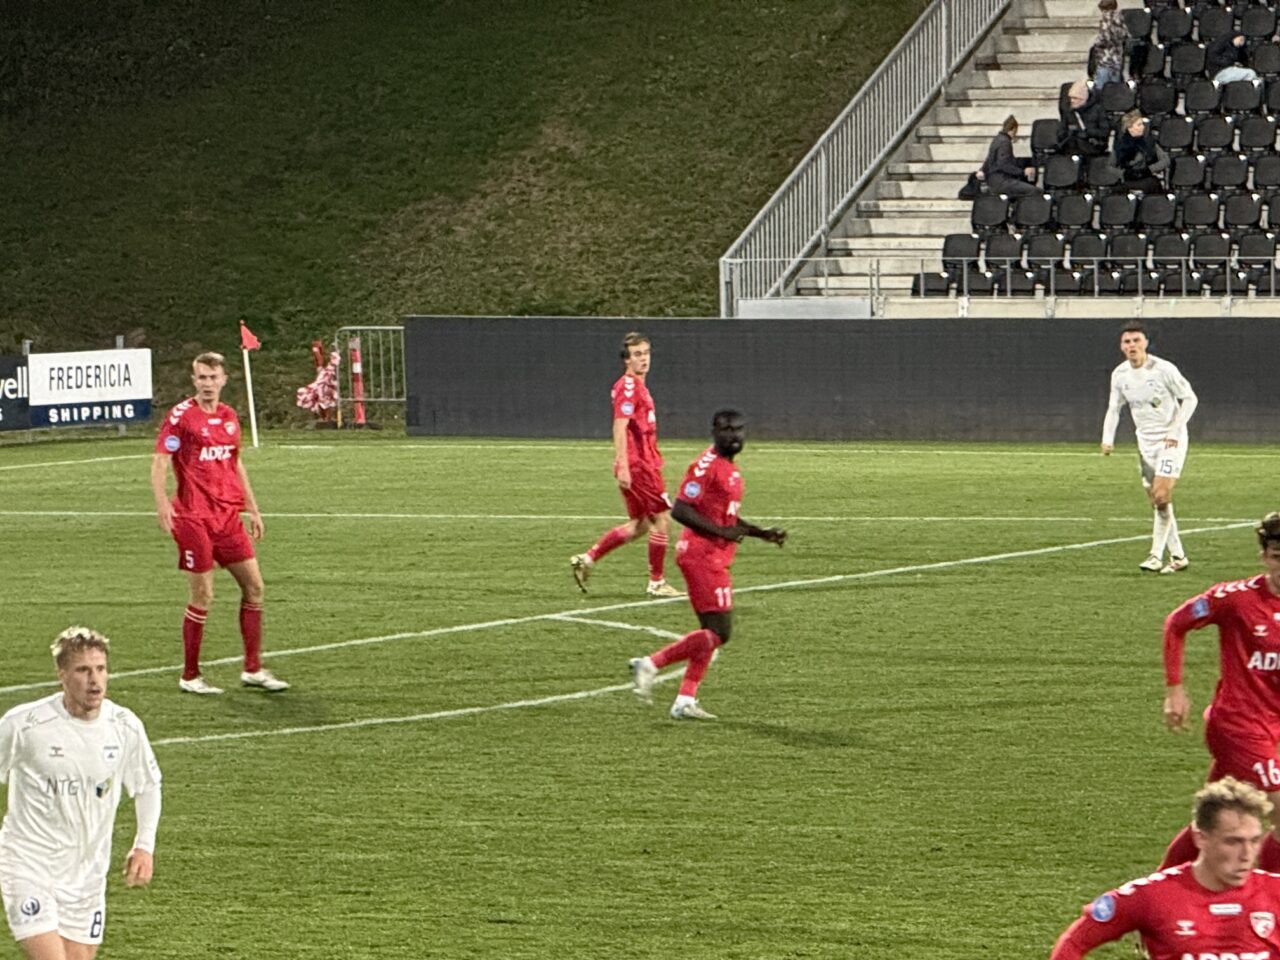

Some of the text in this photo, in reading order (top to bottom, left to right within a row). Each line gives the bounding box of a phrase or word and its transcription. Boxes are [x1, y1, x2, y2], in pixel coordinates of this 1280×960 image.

[49, 363, 132, 391] FREDERICIA
[48, 404, 135, 423] SHIPPING
[1160, 459, 1173, 475] 15
[185, 550, 195, 569] 5
[714, 586, 732, 607] 11
[90, 911, 103, 938] 8
